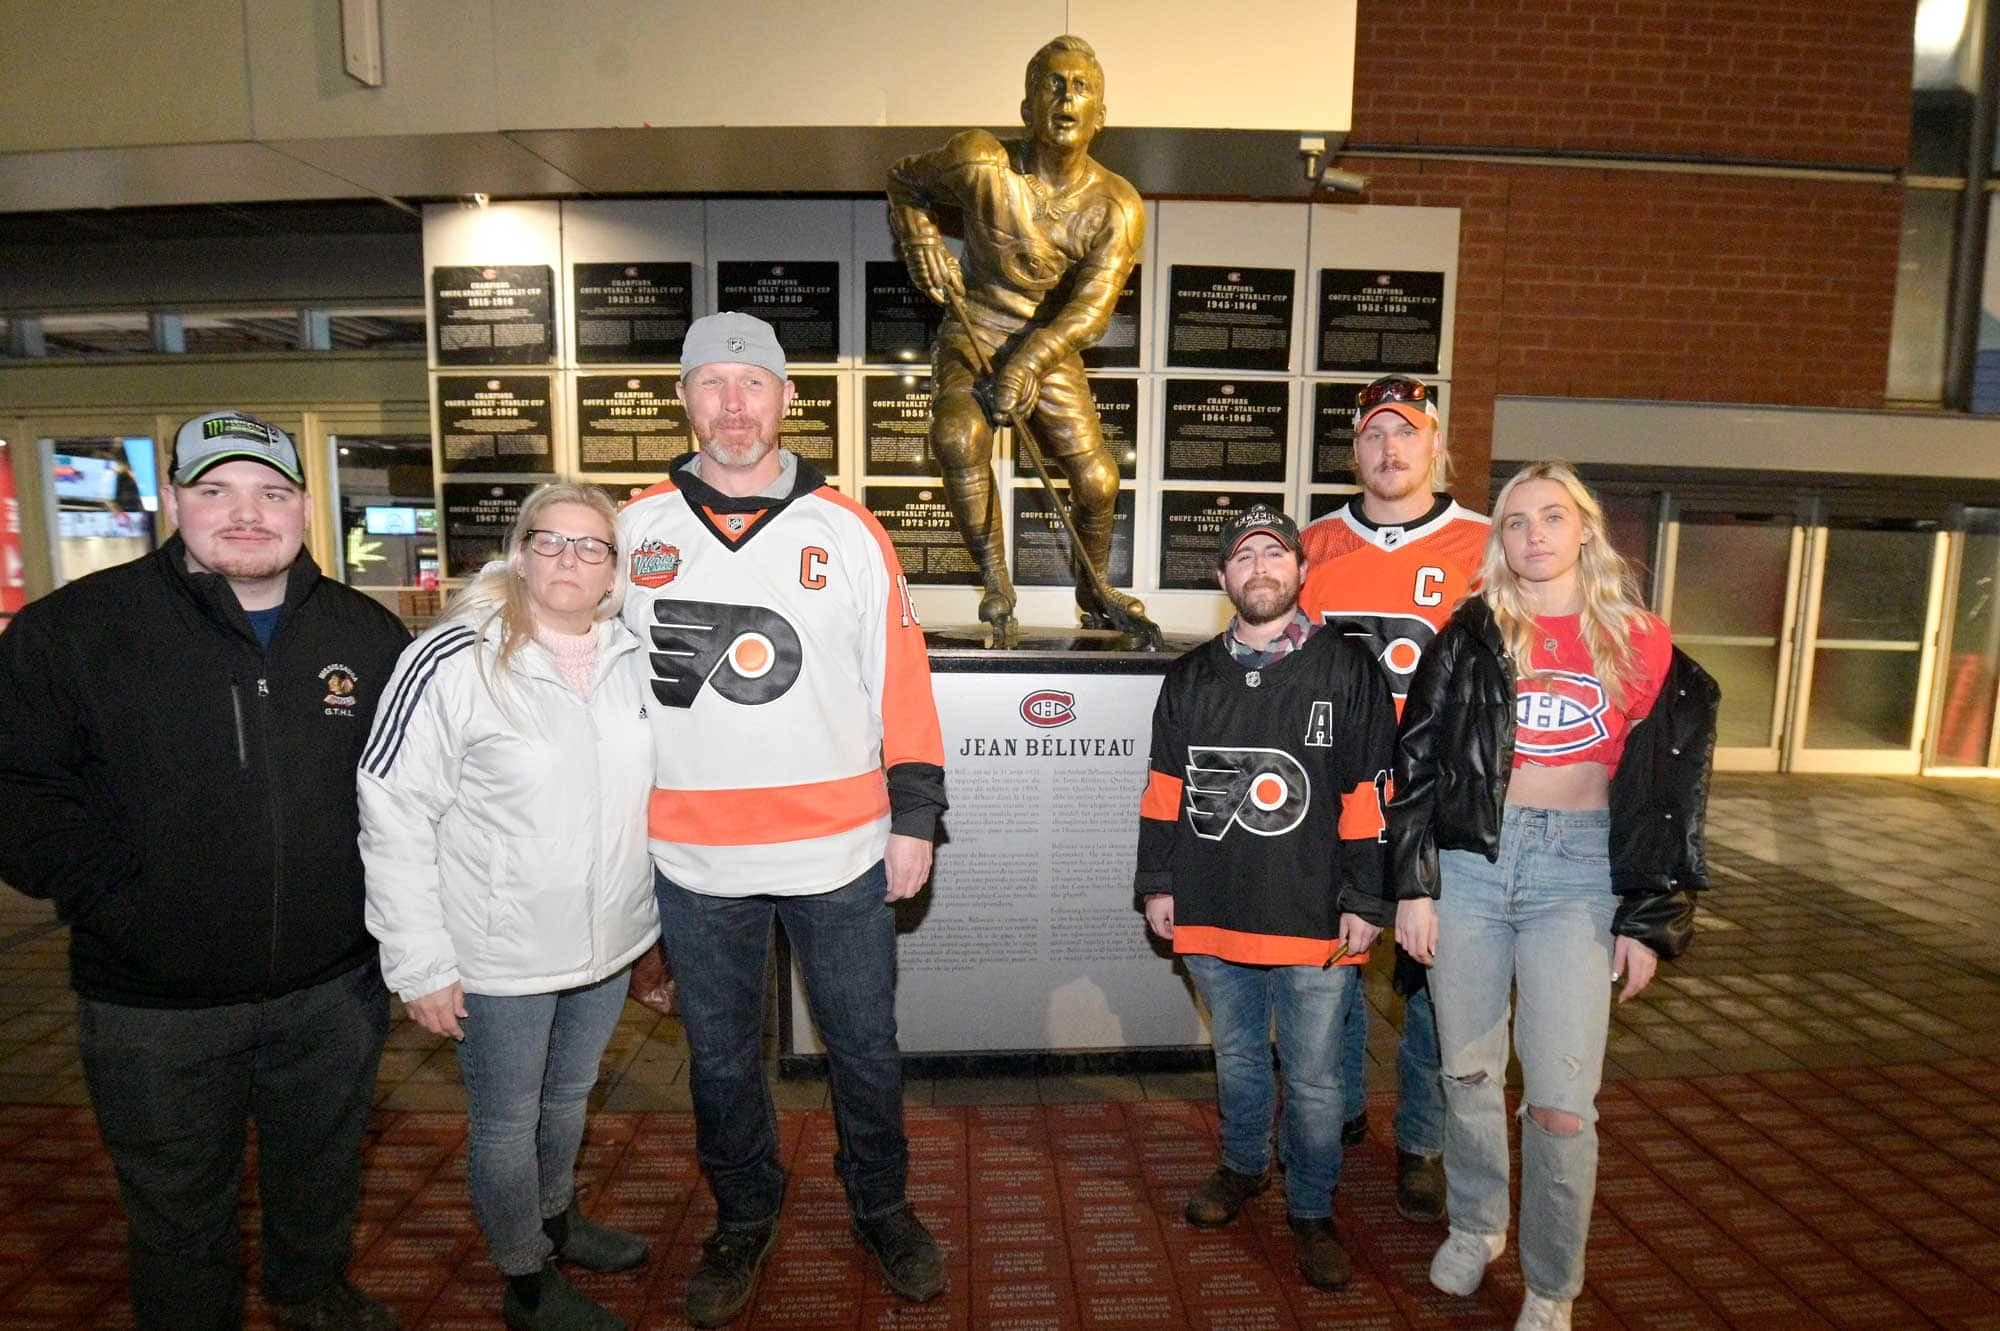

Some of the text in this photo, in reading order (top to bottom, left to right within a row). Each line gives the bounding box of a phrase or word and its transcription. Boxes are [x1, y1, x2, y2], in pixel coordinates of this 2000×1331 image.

[1207, 300, 1257, 310] 1945-1946
[800, 546, 828, 590] C
[1414, 566, 1446, 607] C
[1304, 700, 1333, 747] A
[960, 734, 1136, 756] JEAN BÉLIVEAU
